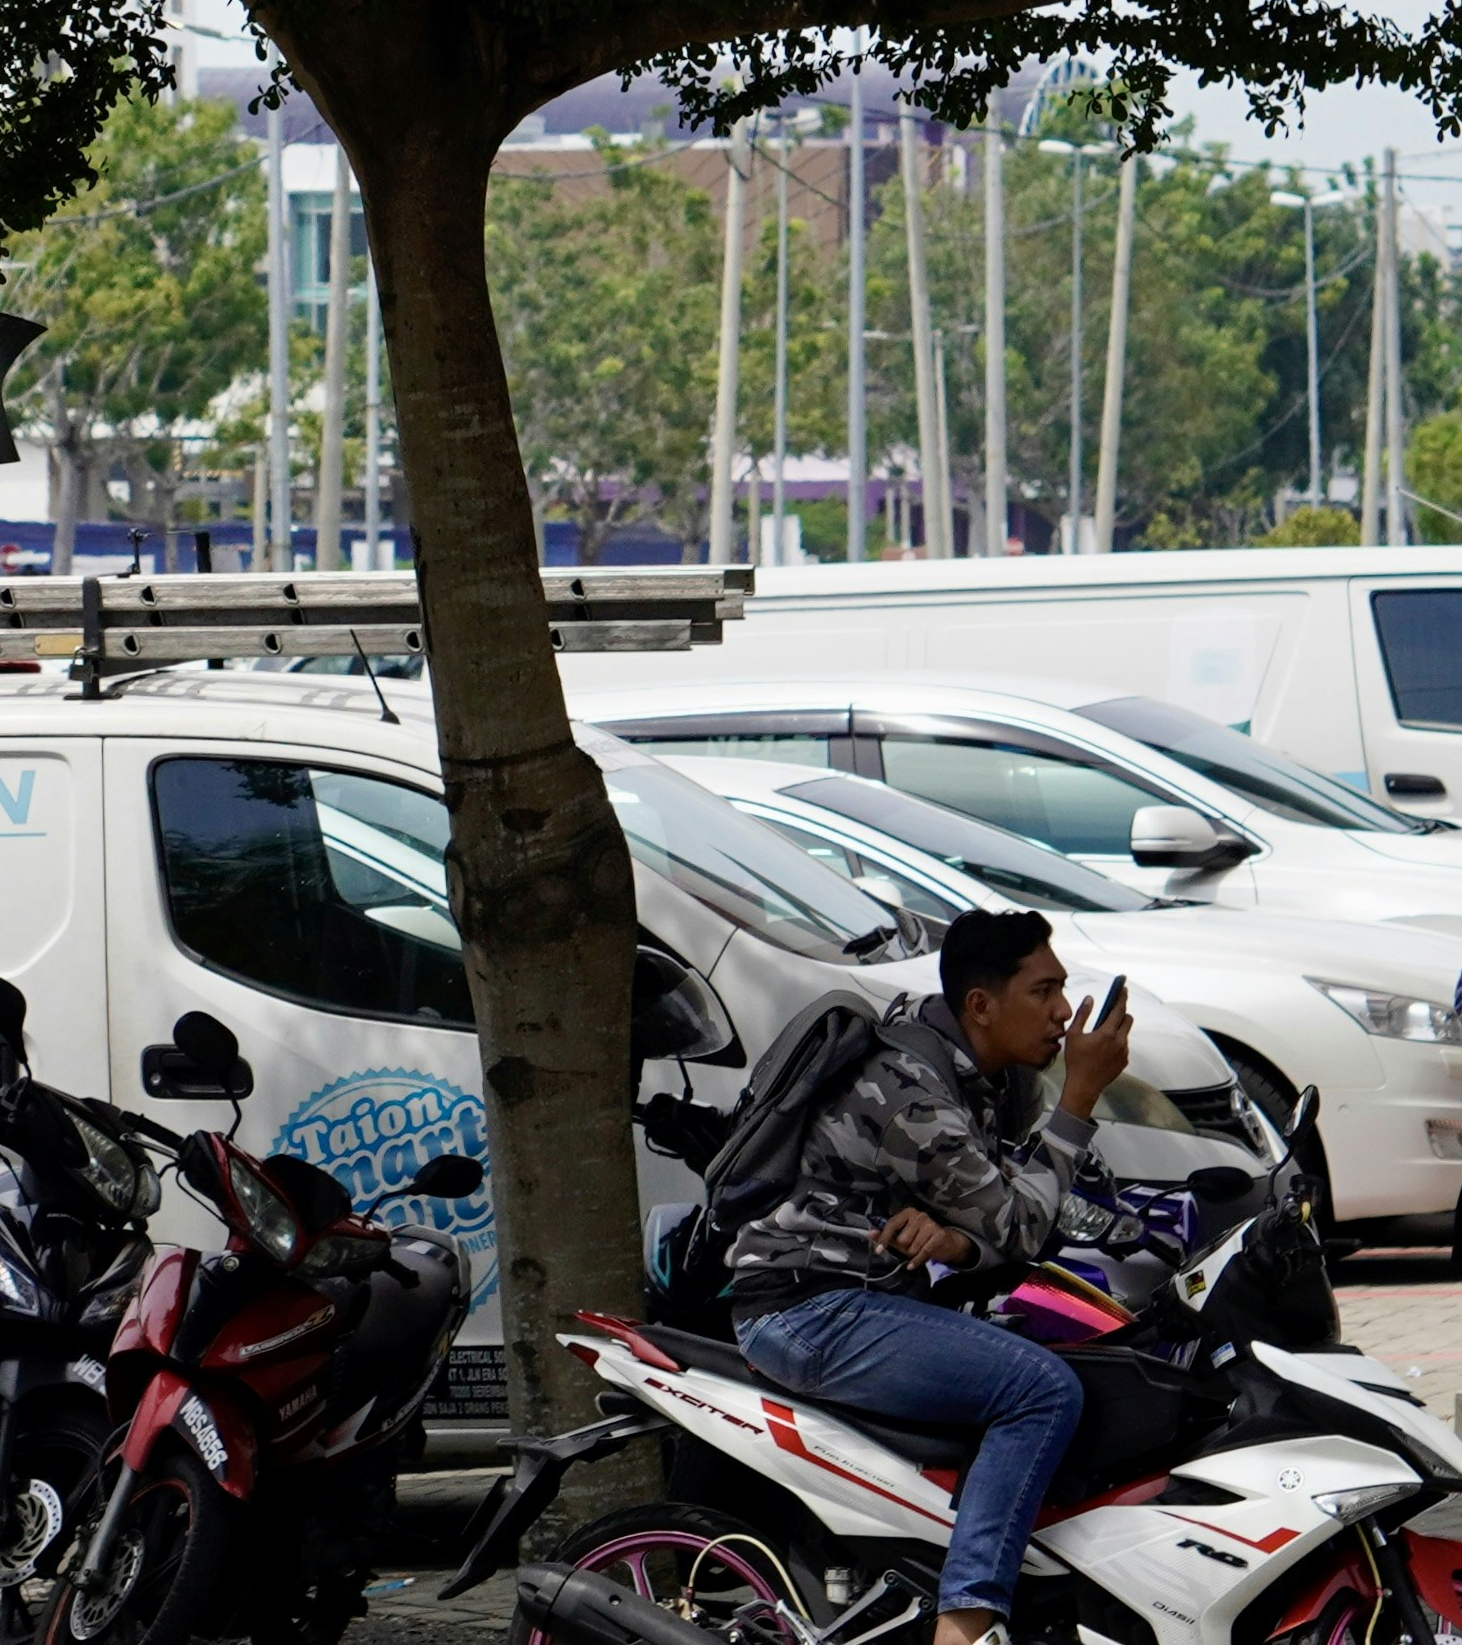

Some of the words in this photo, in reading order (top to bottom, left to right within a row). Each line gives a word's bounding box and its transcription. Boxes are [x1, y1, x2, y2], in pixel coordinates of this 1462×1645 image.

[292, 1091, 442, 1165] Taion
[278, 1384, 317, 1422] YAMAHA
[643, 1377, 765, 1436] EXCITER
